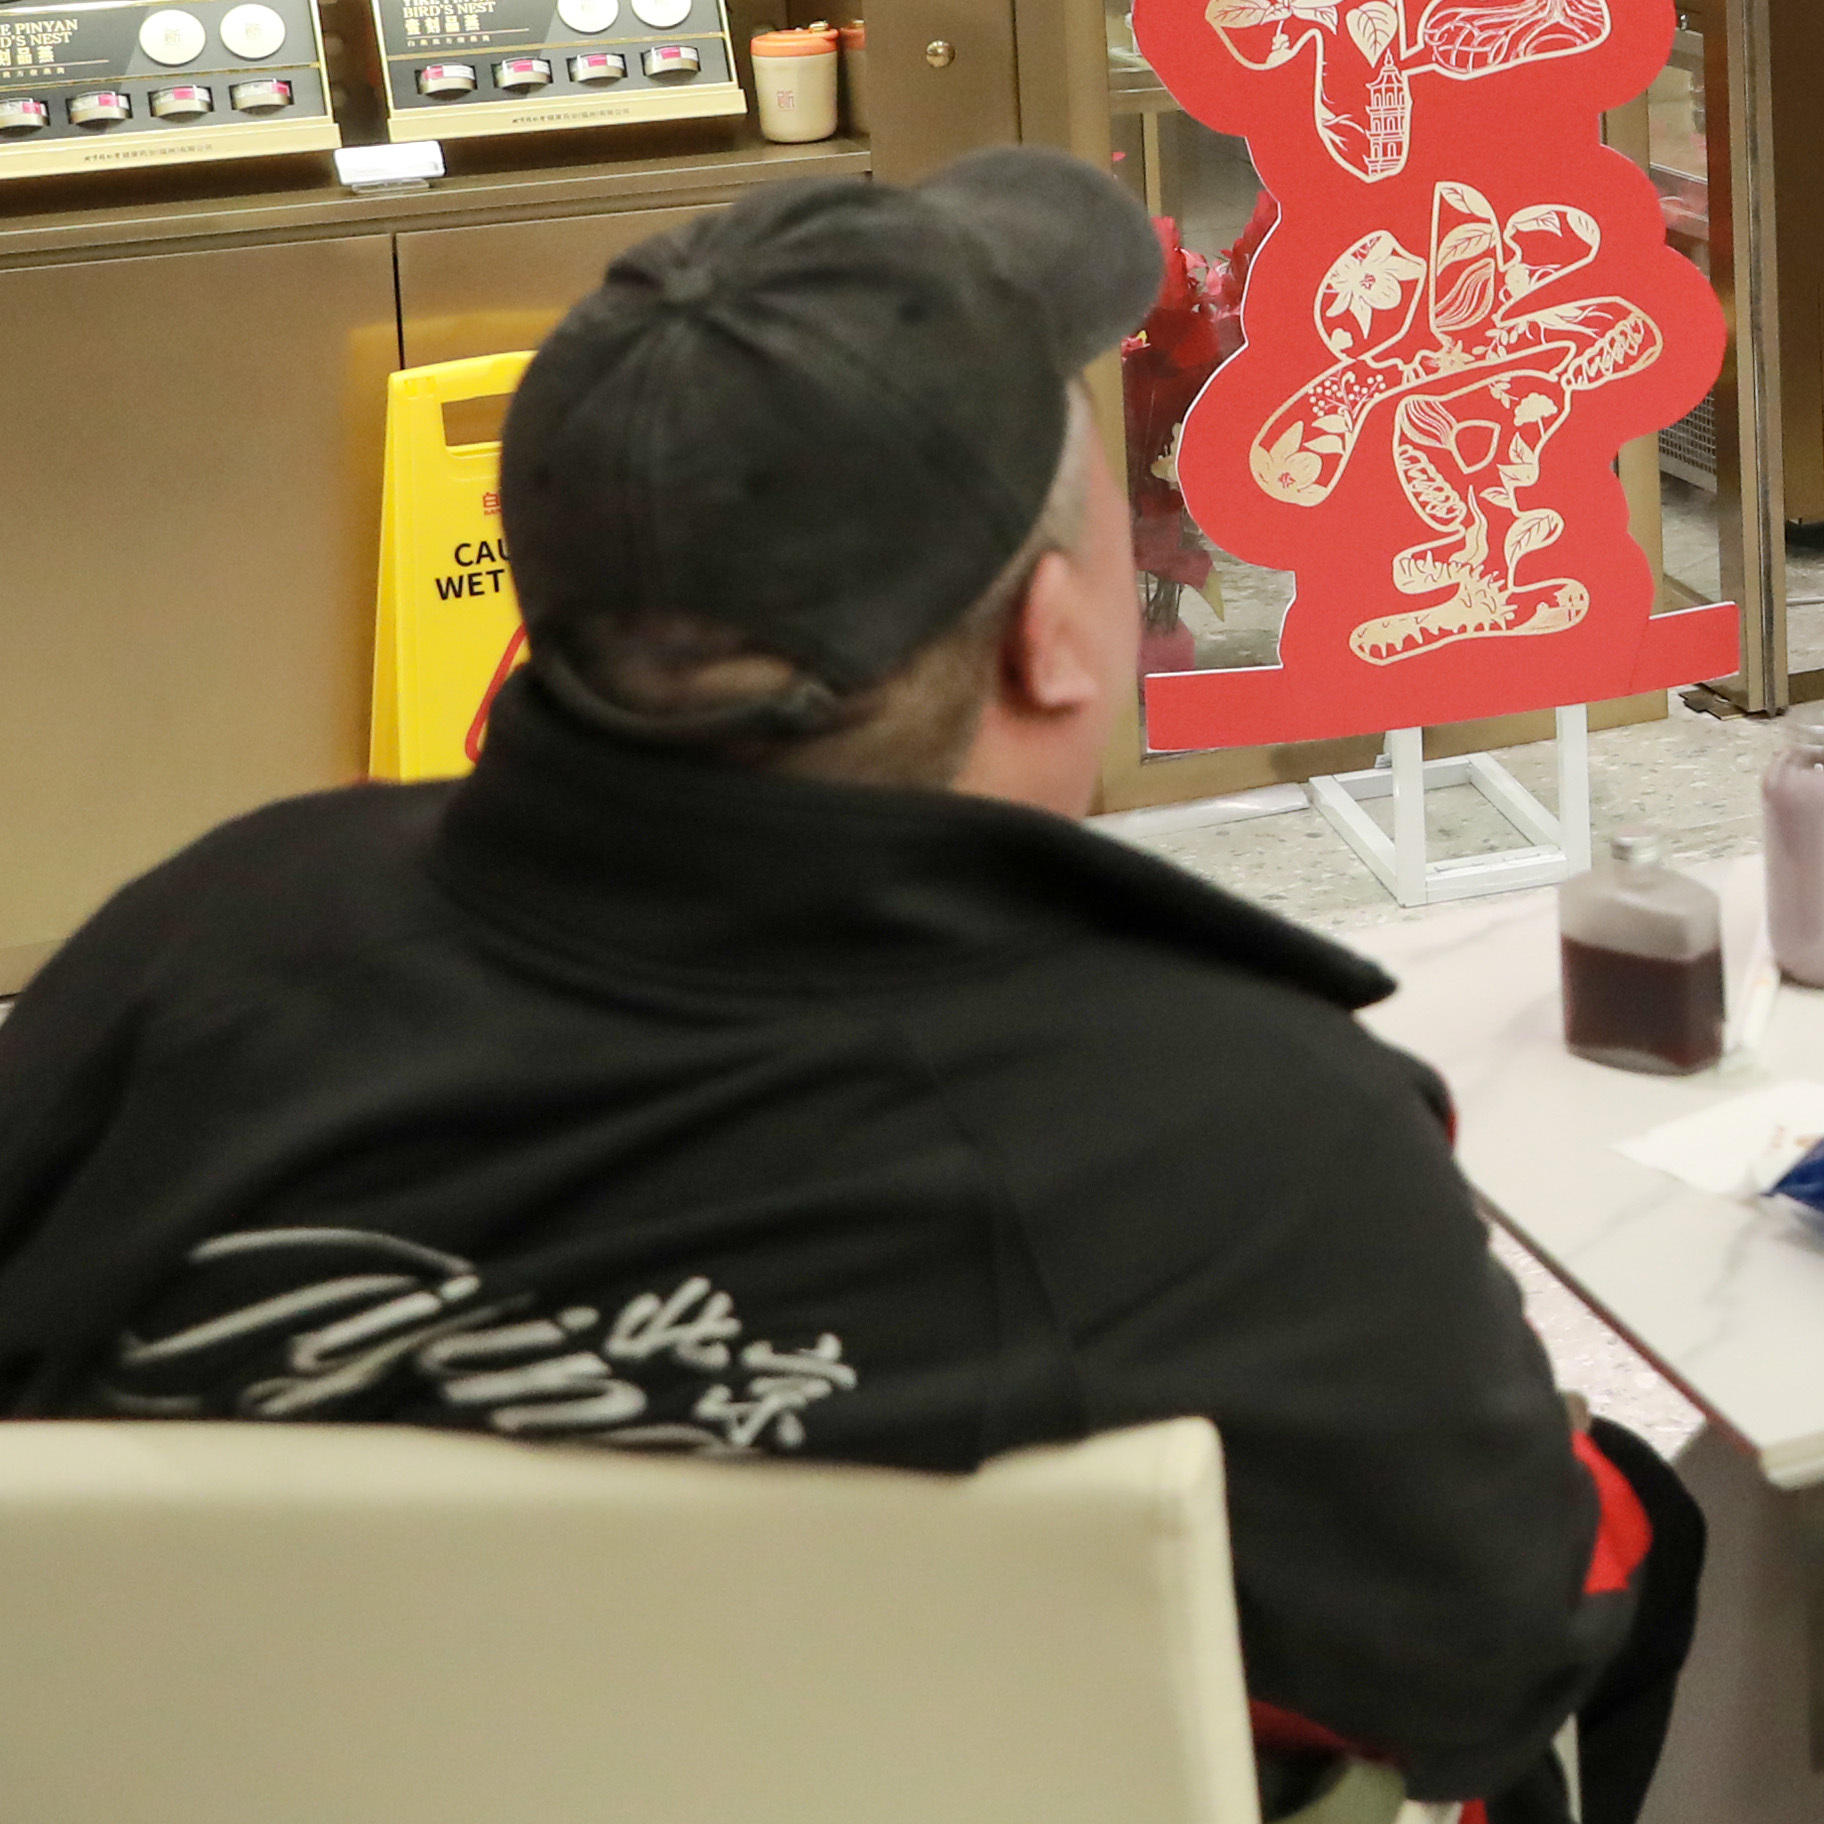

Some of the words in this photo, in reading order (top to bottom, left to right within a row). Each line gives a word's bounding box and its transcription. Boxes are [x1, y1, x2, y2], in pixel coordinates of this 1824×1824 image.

[402, 3, 449, 19] BIRD'S
[452, 0, 497, 16] NEST
[17, 19, 79, 33] PINYAN
[30, 31, 73, 46] NEST
[436, 568, 503, 602] WET
